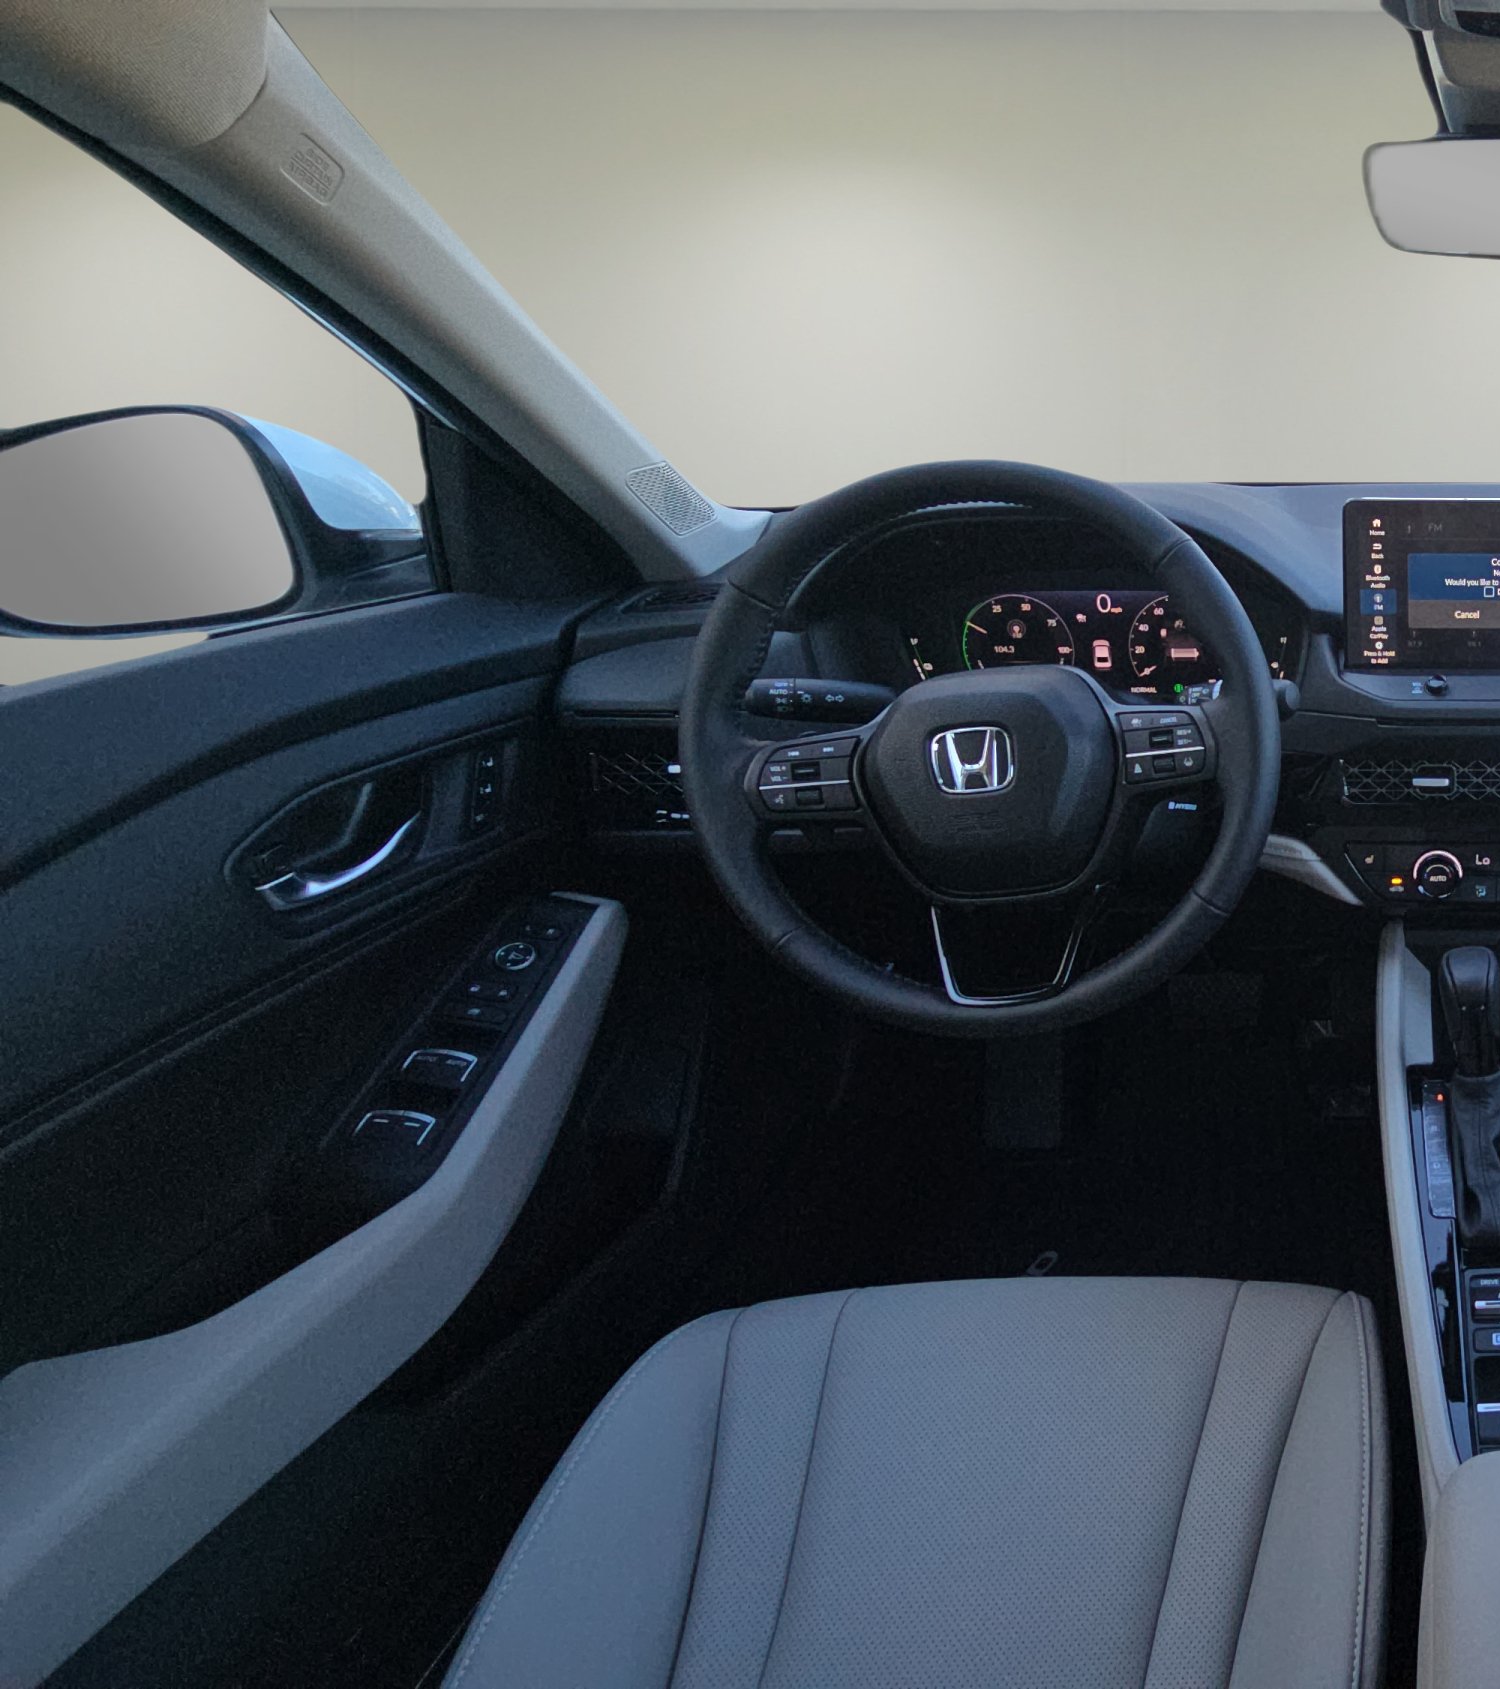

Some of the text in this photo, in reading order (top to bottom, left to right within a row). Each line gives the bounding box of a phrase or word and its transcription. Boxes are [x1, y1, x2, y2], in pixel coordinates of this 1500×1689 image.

[1467, 580, 1479, 588] you
[1020, 603, 1031, 611] 50
[1096, 593, 1111, 613] 0
[992, 604, 1002, 613] 25
[1153, 607, 1164, 616] 60
[1454, 611, 1480, 619] Cancel
[1046, 618, 1057, 627] 75
[1138, 623, 1149, 632] 40
[993, 645, 1015, 654] 104.3
[1057, 646, 1070, 654] 100
[1134, 645, 1145, 654] 20
[1475, 854, 1490, 866] Lo
